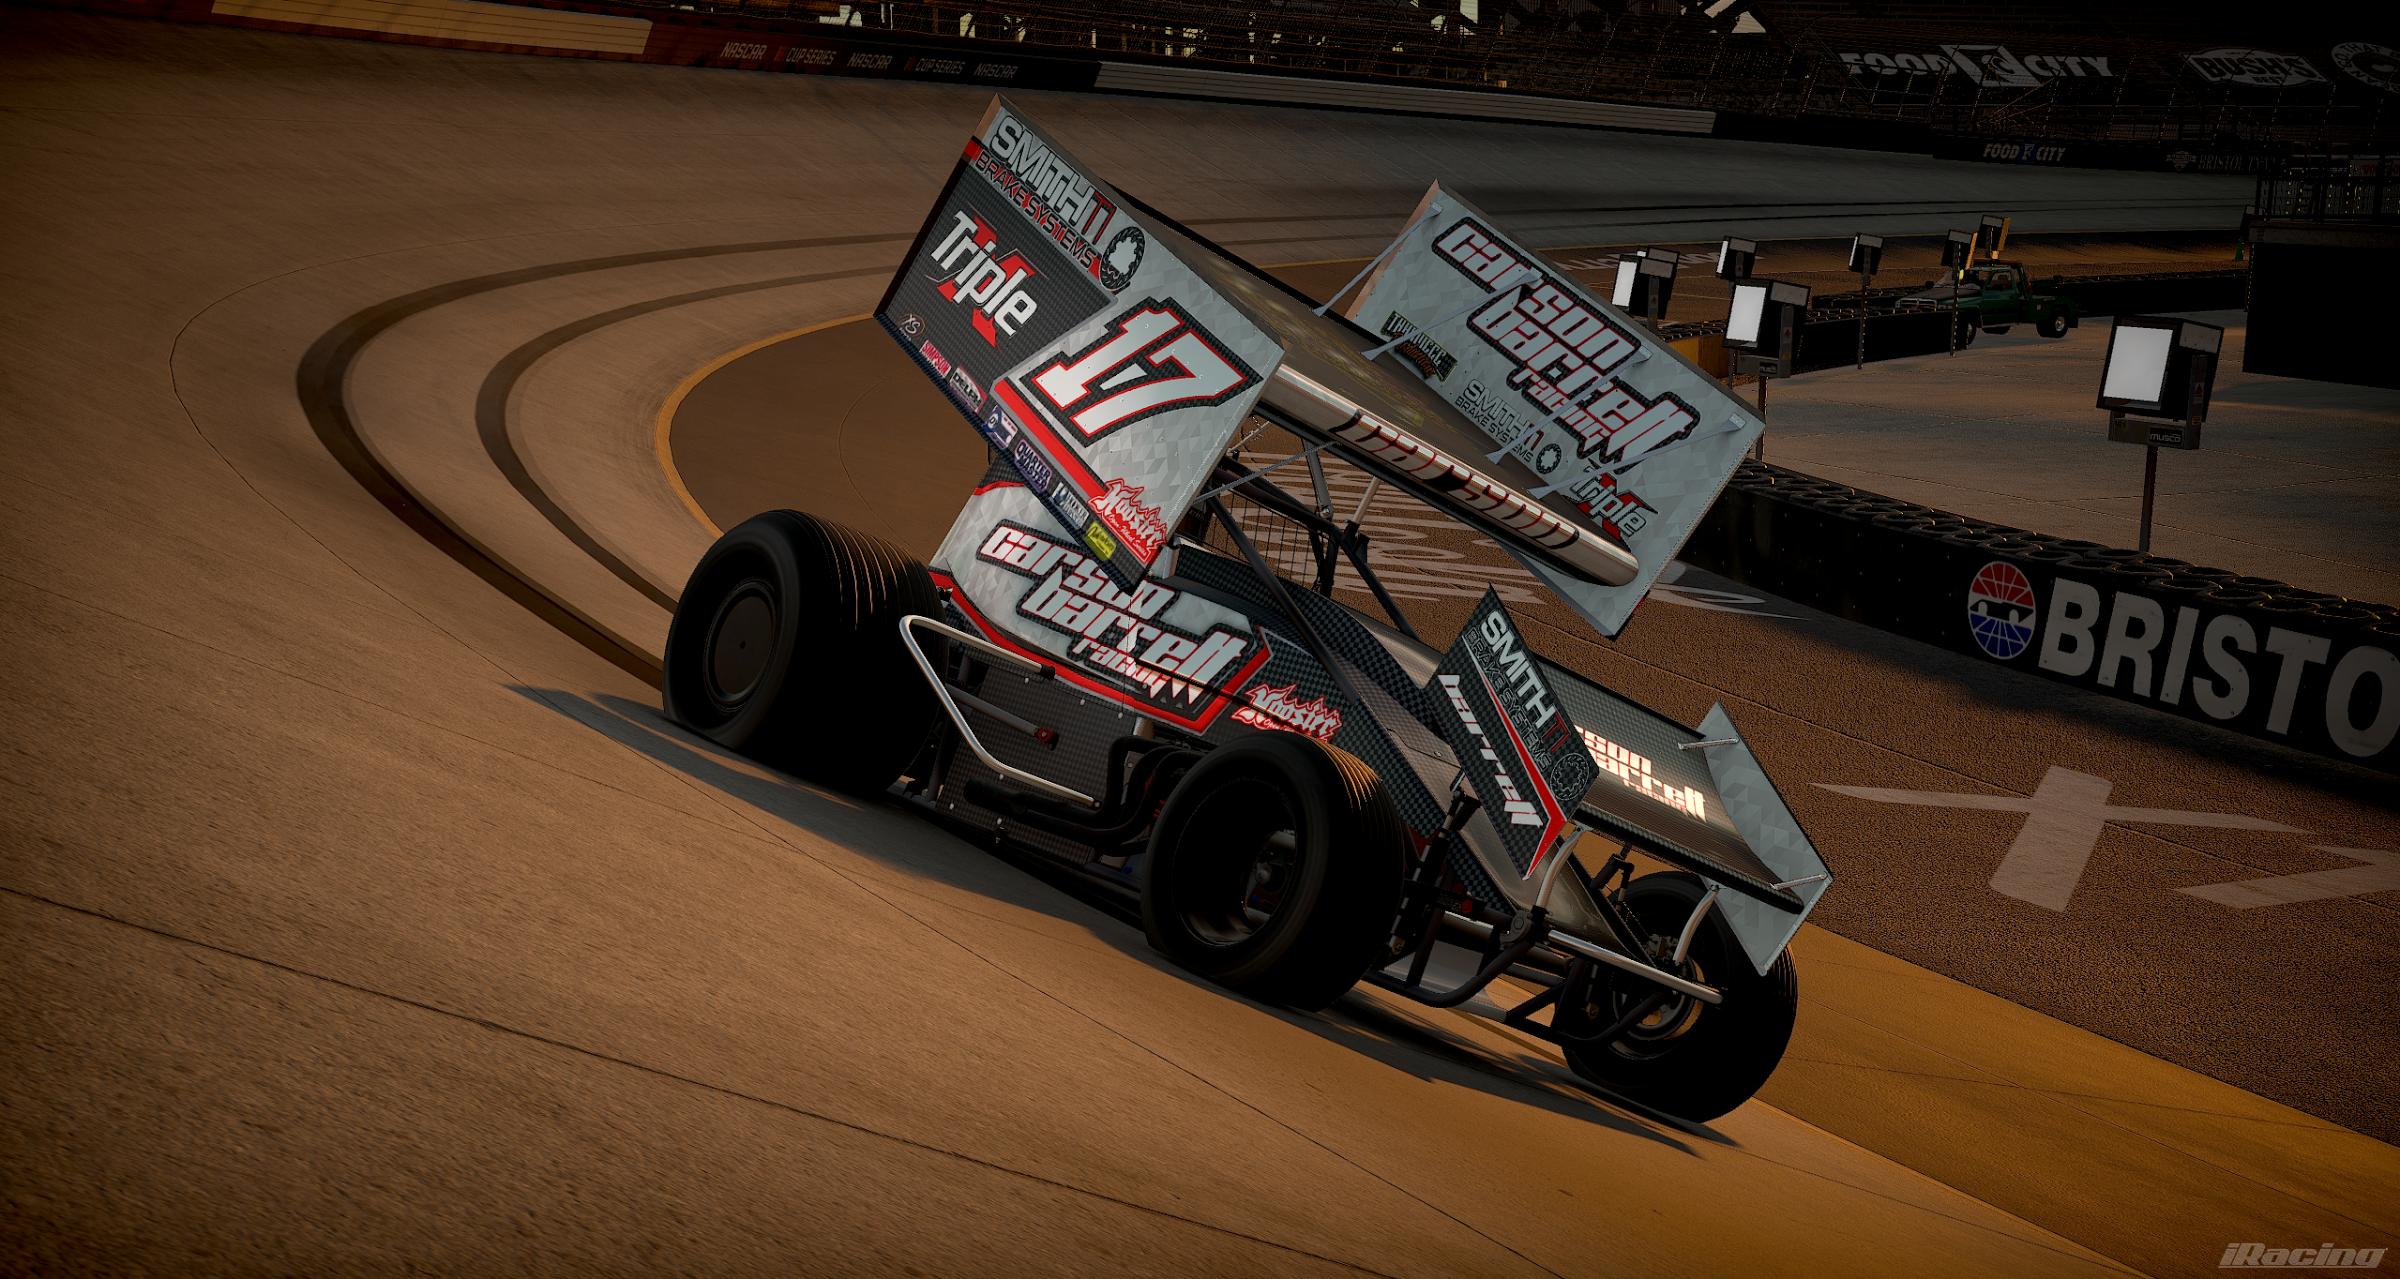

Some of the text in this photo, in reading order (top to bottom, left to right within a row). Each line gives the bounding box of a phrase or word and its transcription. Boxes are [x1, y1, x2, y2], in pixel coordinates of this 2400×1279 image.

[720, 41, 767, 60] NASCAR
[847, 52, 893, 70] NASCAR
[975, 63, 1018, 78] NASCAR
[2023, 55, 2113, 77] CITY
[1982, 143, 2019, 159] FOOD
[2036, 146, 2066, 162] CITY
[975, 150, 1097, 270] BRAKE SYSTEMS
[930, 209, 1039, 337] Triple
[921, 341, 950, 376] SIMPSON
[1031, 304, 1249, 440] 17
[1455, 396, 1490, 427] BRAKE
[1017, 441, 1051, 478] QUARTER
[1020, 455, 1047, 490] MASTER
[2038, 577, 2400, 757] BRISTO
[1465, 627, 1551, 772] BRAKE SYSTEMS
